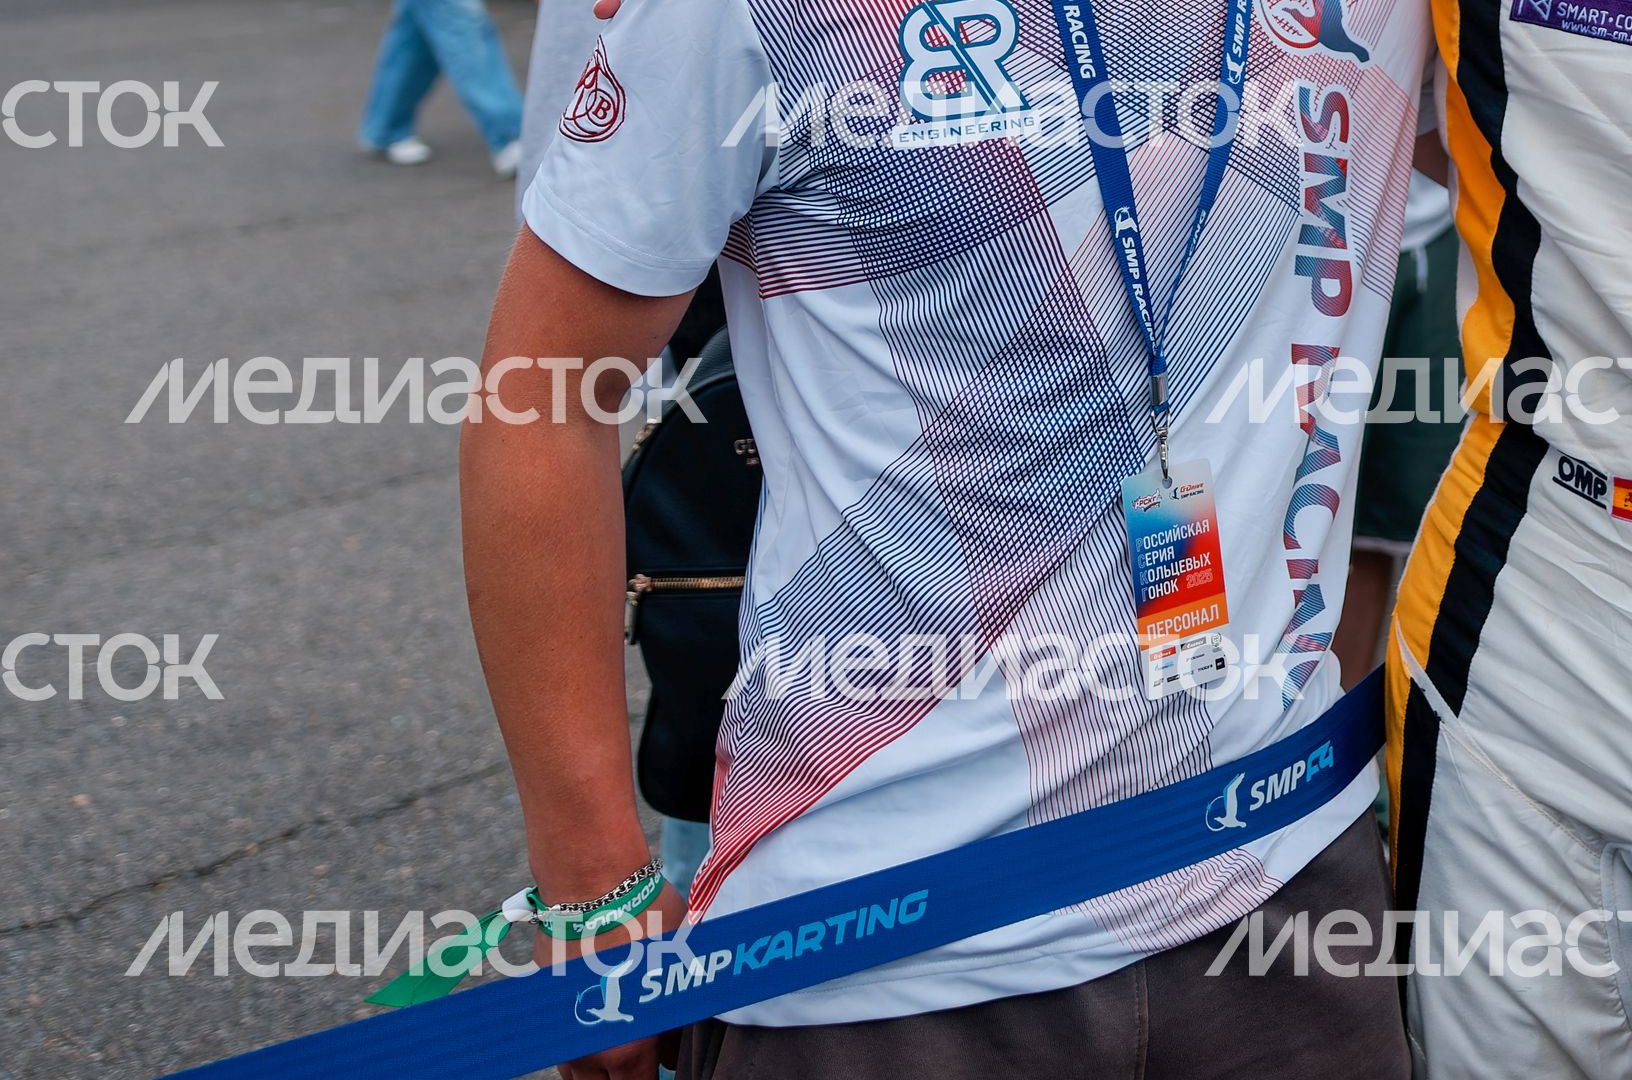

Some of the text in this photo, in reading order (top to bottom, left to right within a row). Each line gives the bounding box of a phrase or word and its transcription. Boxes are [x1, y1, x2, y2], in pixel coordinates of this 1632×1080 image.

[1063, 5, 1097, 80] RACING
[1232, 12, 1246, 58] SMP
[898, 116, 1035, 143] ENGINEERING
[1294, 85, 1353, 318] SMP
[1122, 236, 1141, 280] SMP
[1557, 455, 1608, 501] OMP
[1135, 519, 1211, 553] РОССИЙСКАЯ
[1138, 545, 1176, 570] СЕРИЯ
[1140, 552, 1212, 586] КОЛЬЦЕВЫХ
[1141, 579, 1180, 602] ГОНОК
[1145, 603, 1220, 642] ПЕРСОНАЛ
[585, 880, 656, 930] FORMULA
